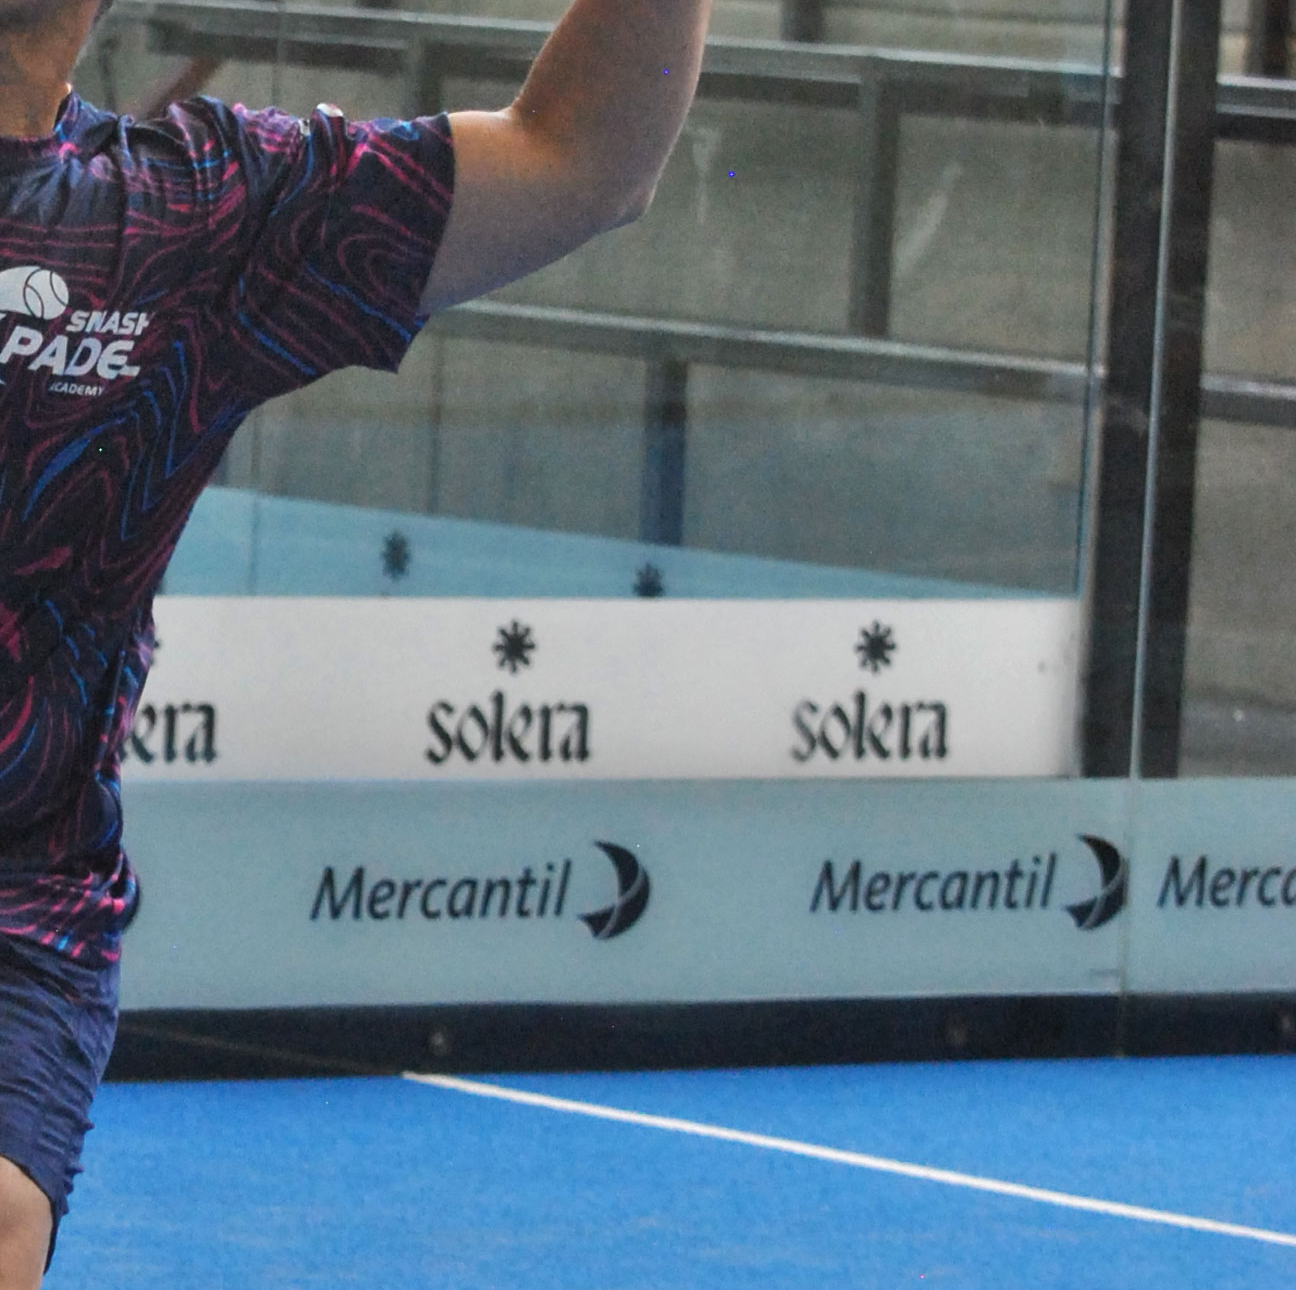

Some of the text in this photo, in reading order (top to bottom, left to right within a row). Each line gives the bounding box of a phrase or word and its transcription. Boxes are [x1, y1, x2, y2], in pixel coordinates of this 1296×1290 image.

[120, 699, 220, 764] era
[425, 688, 592, 765] solera
[792, 689, 951, 763] solera
[310, 858, 572, 920] Mercantil
[810, 851, 1058, 913] Mercantil
